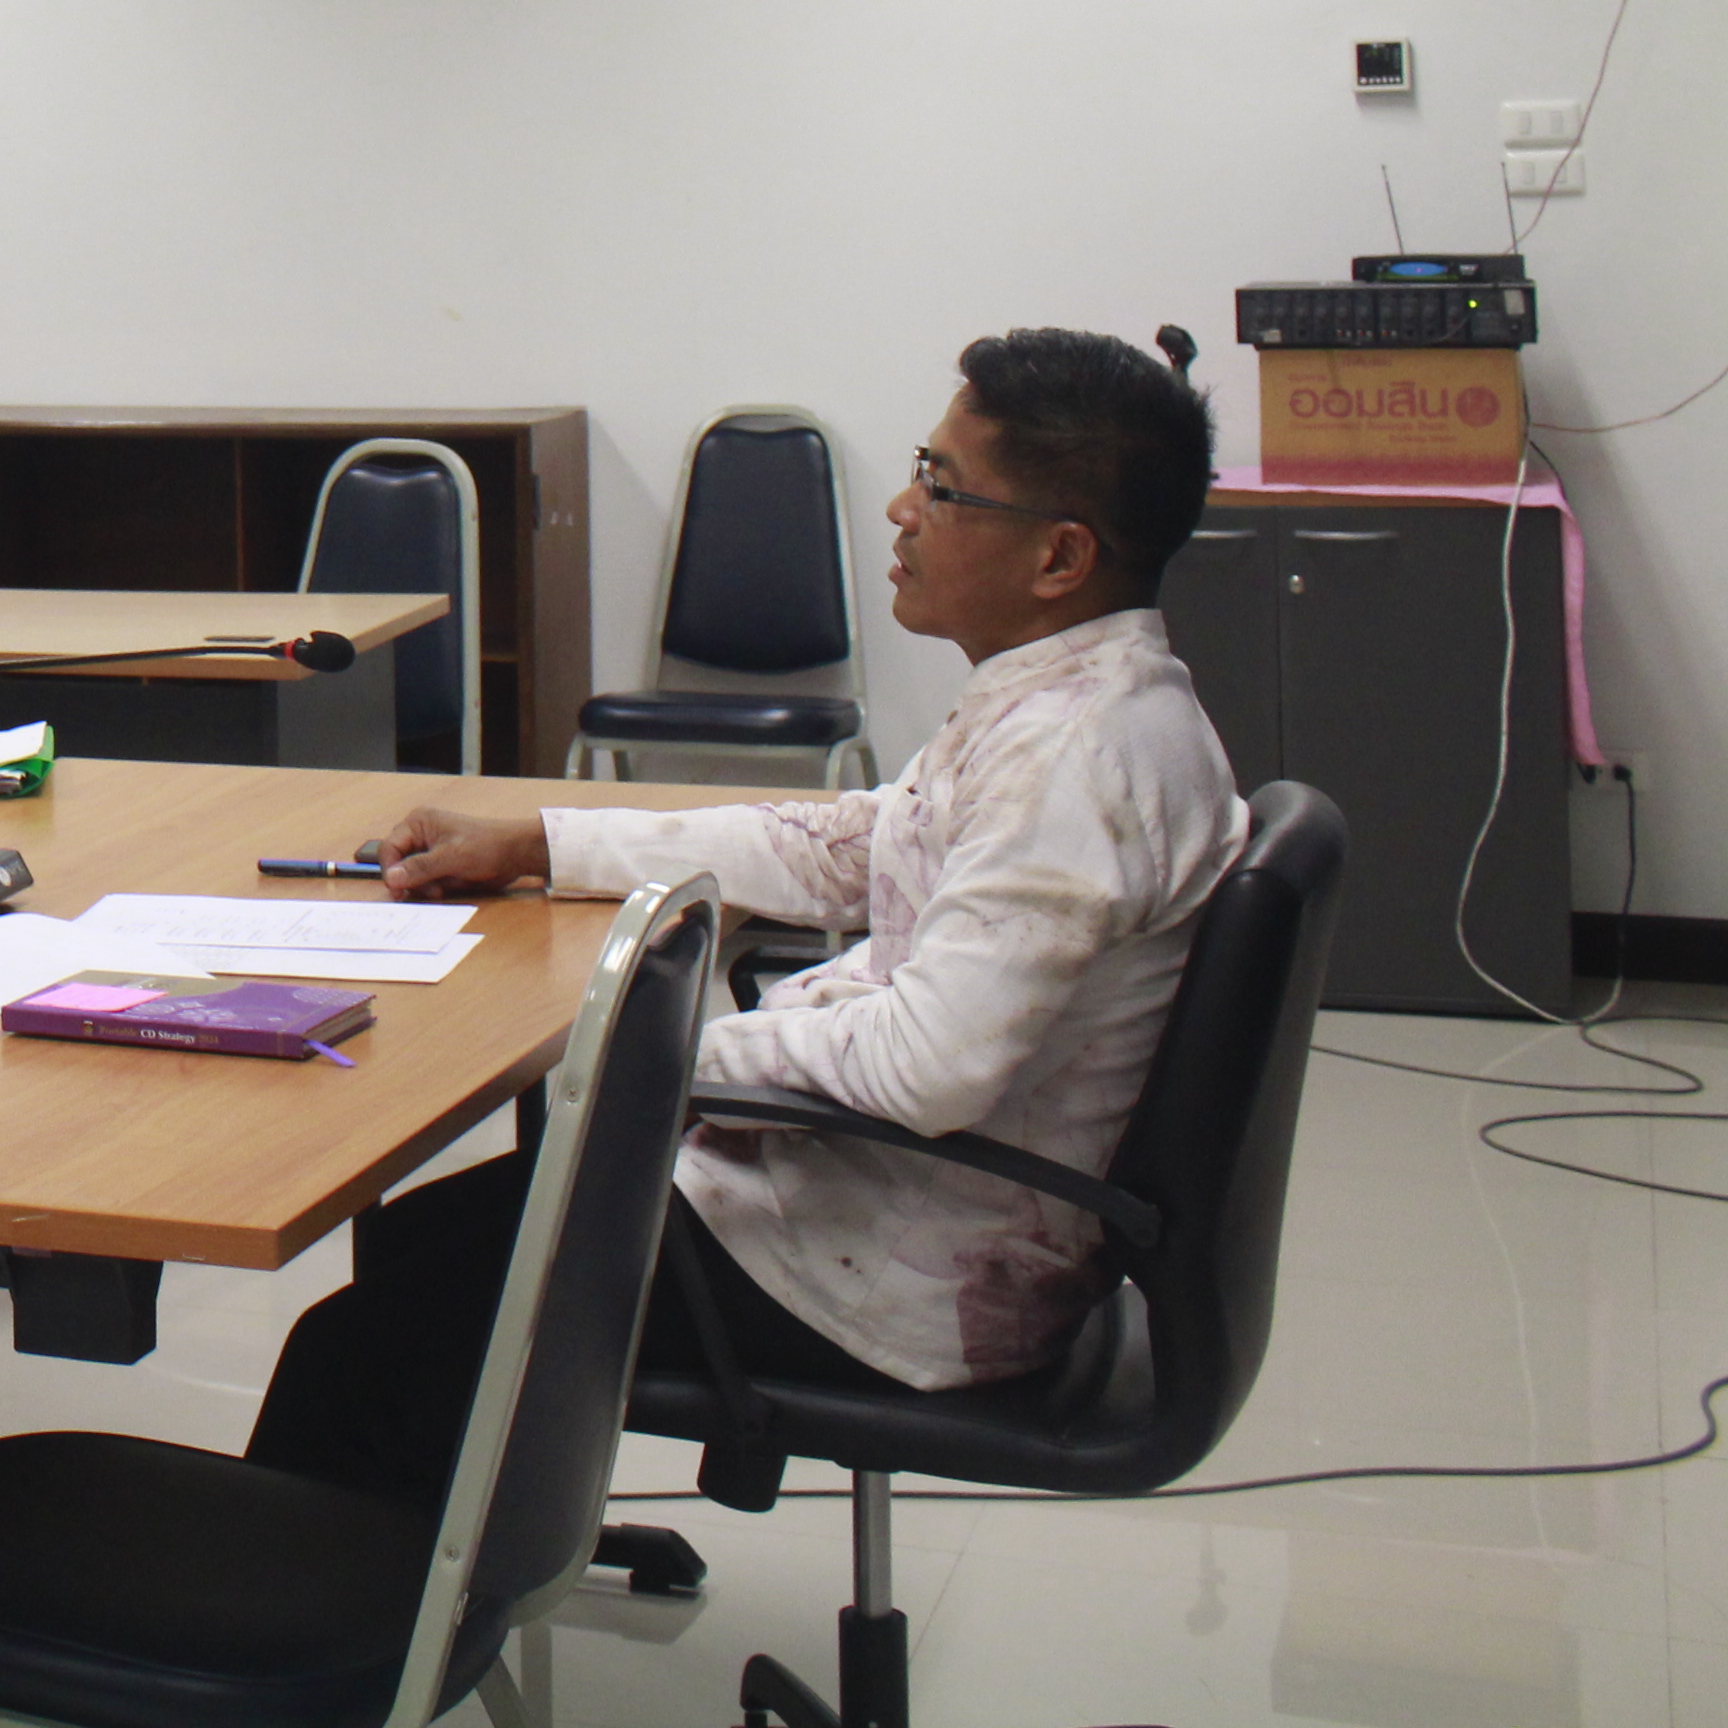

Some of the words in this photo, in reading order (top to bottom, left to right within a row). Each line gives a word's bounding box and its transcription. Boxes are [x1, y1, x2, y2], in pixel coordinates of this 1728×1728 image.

[1289, 382, 1449, 419] ออมสิน
[140, 1028, 157, 1039] CD
[158, 1031, 196, 1045] Strategy
